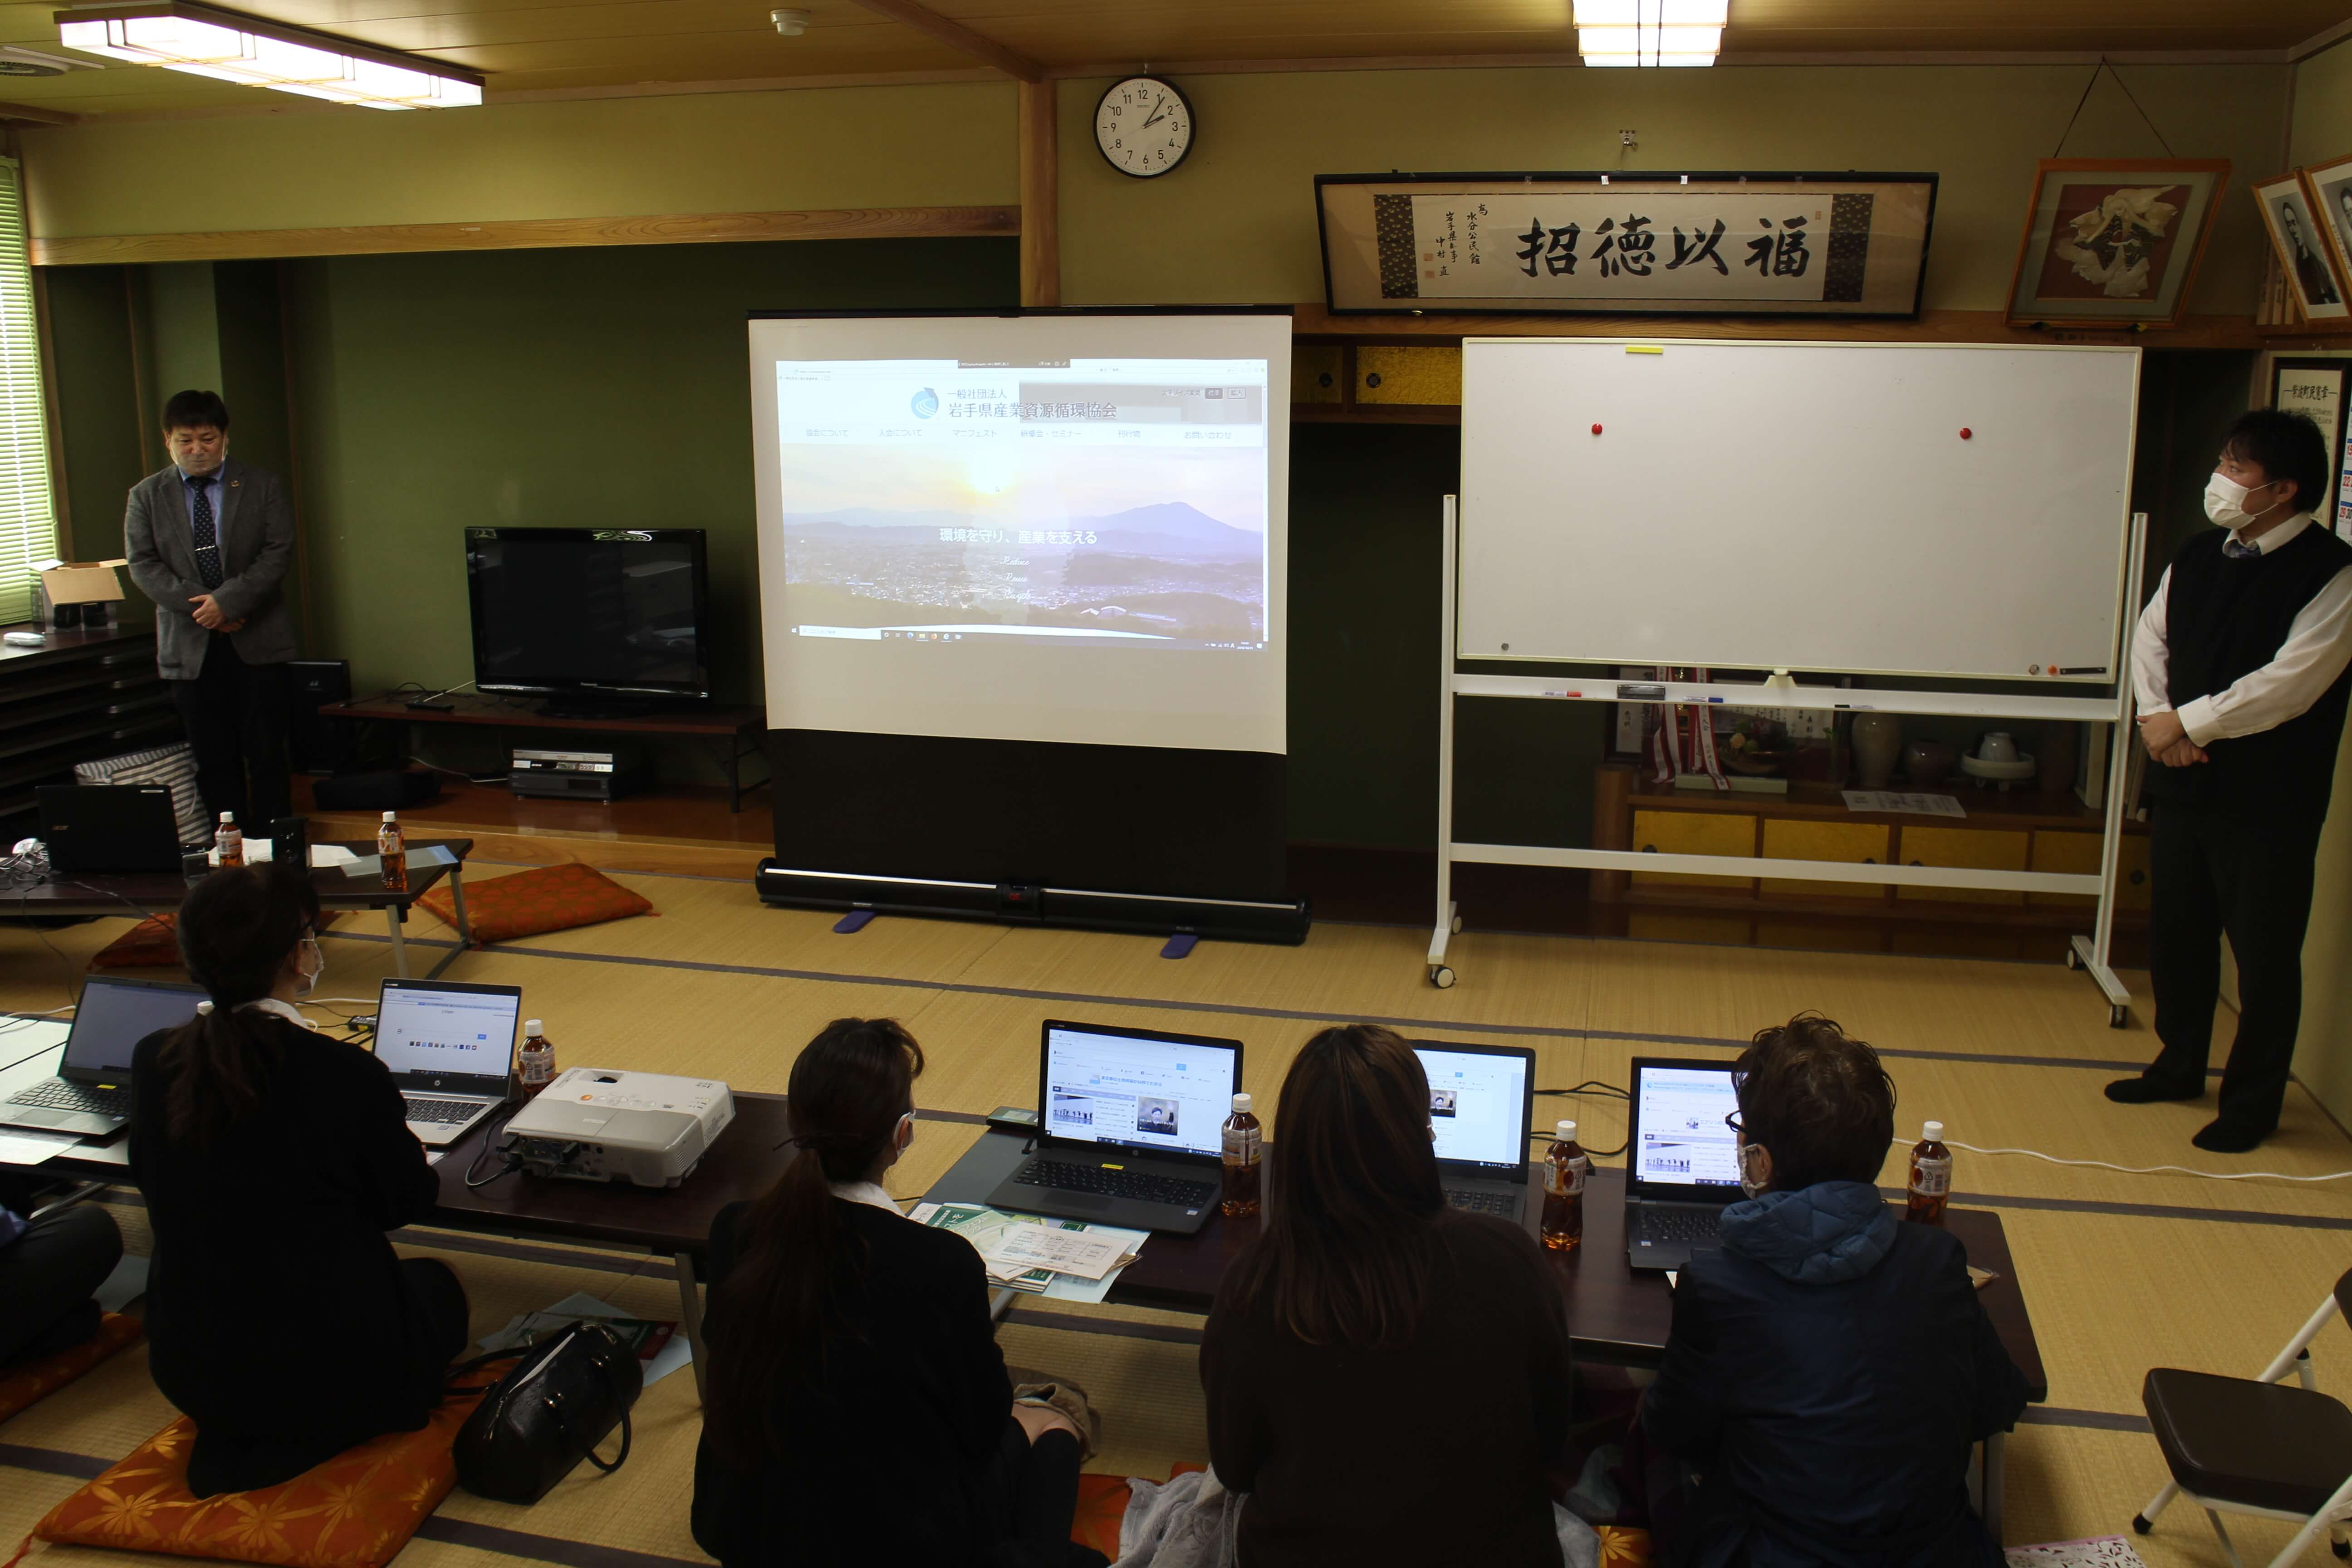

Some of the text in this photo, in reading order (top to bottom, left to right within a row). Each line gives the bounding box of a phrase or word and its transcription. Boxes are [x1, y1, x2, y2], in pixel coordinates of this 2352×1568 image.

[1123, 94, 1132, 104] 11
[1138, 90, 1147, 99] 12
[1112, 106, 1121, 116] 10
[1167, 106, 1173, 115] 2
[1111, 123, 1116, 132] 9
[1172, 122, 1178, 131] 3
[1115, 139, 1122, 148] 8
[1169, 138, 1175, 147] 4
[1127, 150, 1132, 159] 7
[1143, 154, 1148, 164] 6
[1158, 150, 1164, 159] 5
[947, 389, 1007, 399] 一般社団法人
[948, 402, 1118, 418] 岩手県産業資源循環協会
[806, 428, 849, 437] 協会について
[878, 429, 922, 437] 入会について
[952, 429, 998, 437] マニフェスト
[1020, 429, 1082, 438] 研修会・セミナー
[1118, 430, 1141, 438] 刊行物
[1184, 431, 1232, 440] お問い合わせ
[940, 528, 1097, 544] 環境を守り、産業を支える
[1000, 556, 1030, 566] Reduce
